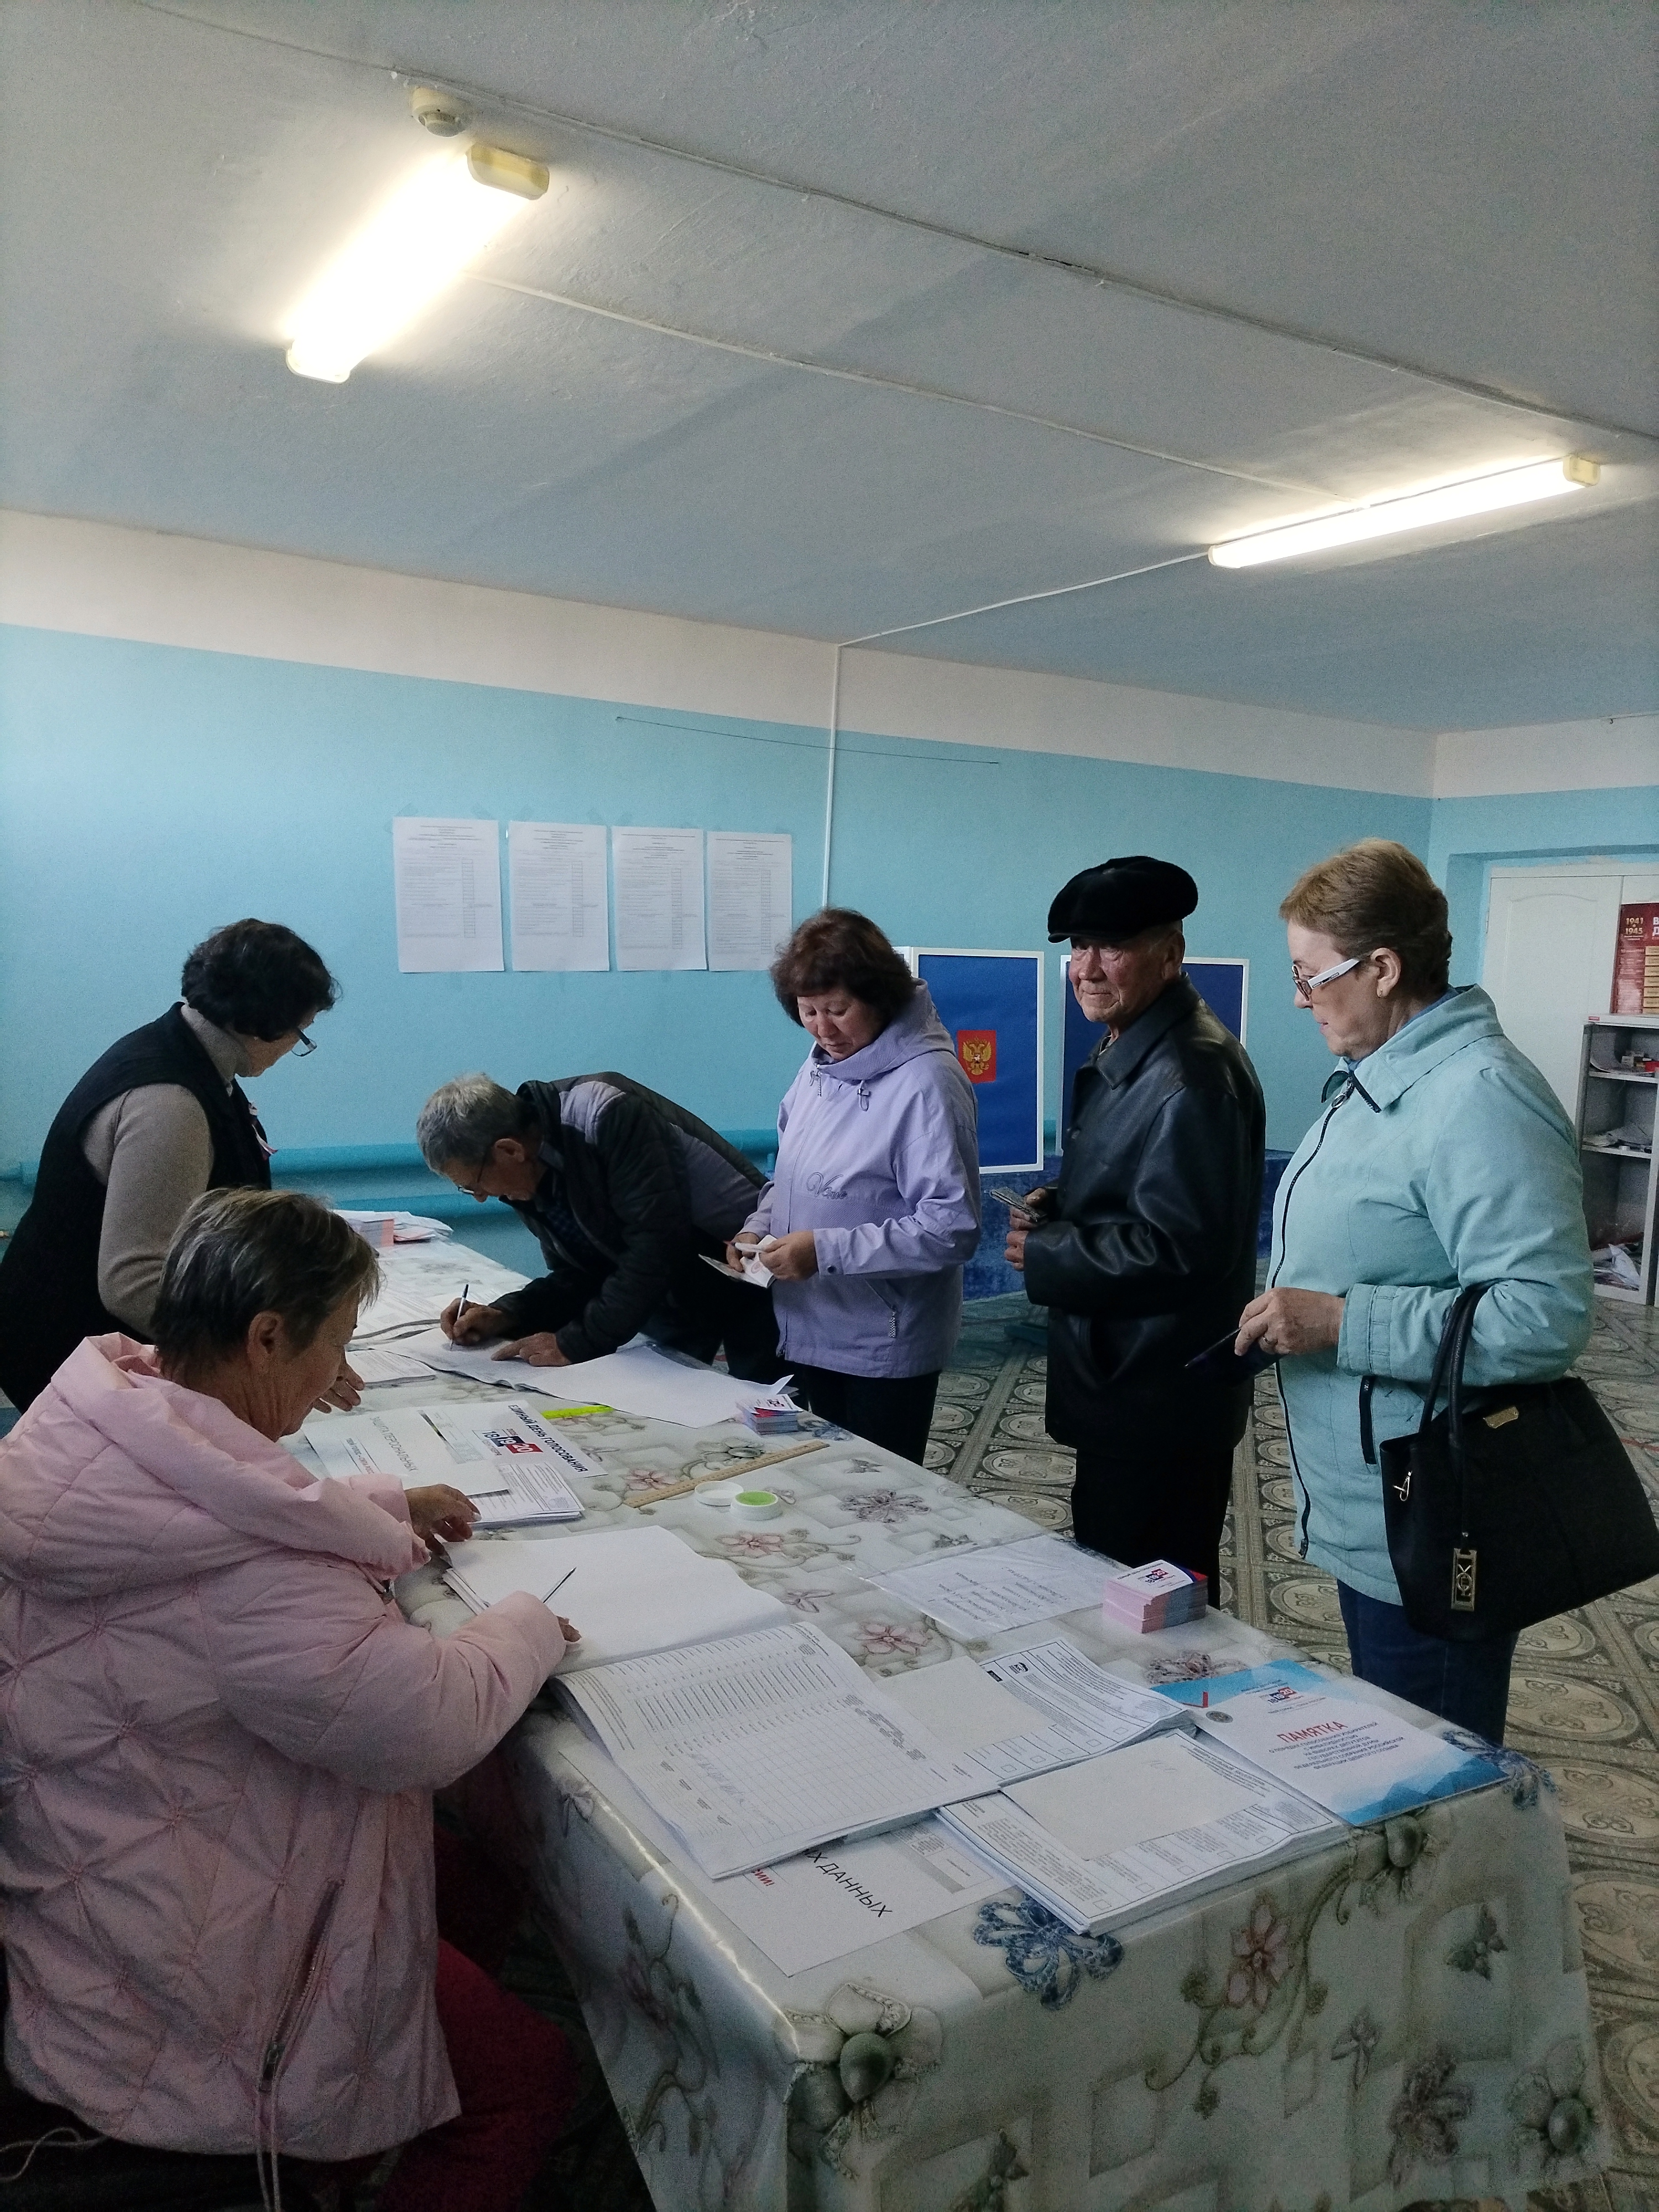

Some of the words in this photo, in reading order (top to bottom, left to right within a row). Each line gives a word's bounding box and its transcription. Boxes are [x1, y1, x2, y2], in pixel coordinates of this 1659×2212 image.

[383, 1433, 419, 1472] ПЕРСОНАЛЬНЫХ
[498, 1436, 517, 1444] 19
[508, 1405, 538, 1427] ЕДИНЫЙ
[526, 1423, 547, 1437] ДЕНЬ
[541, 1438, 588, 1472] ГОЛОСОВАНИЯ
[1277, 1721, 1348, 1743] ПАМЯТКА
[816, 1863, 893, 1917] ДАННЫХ
